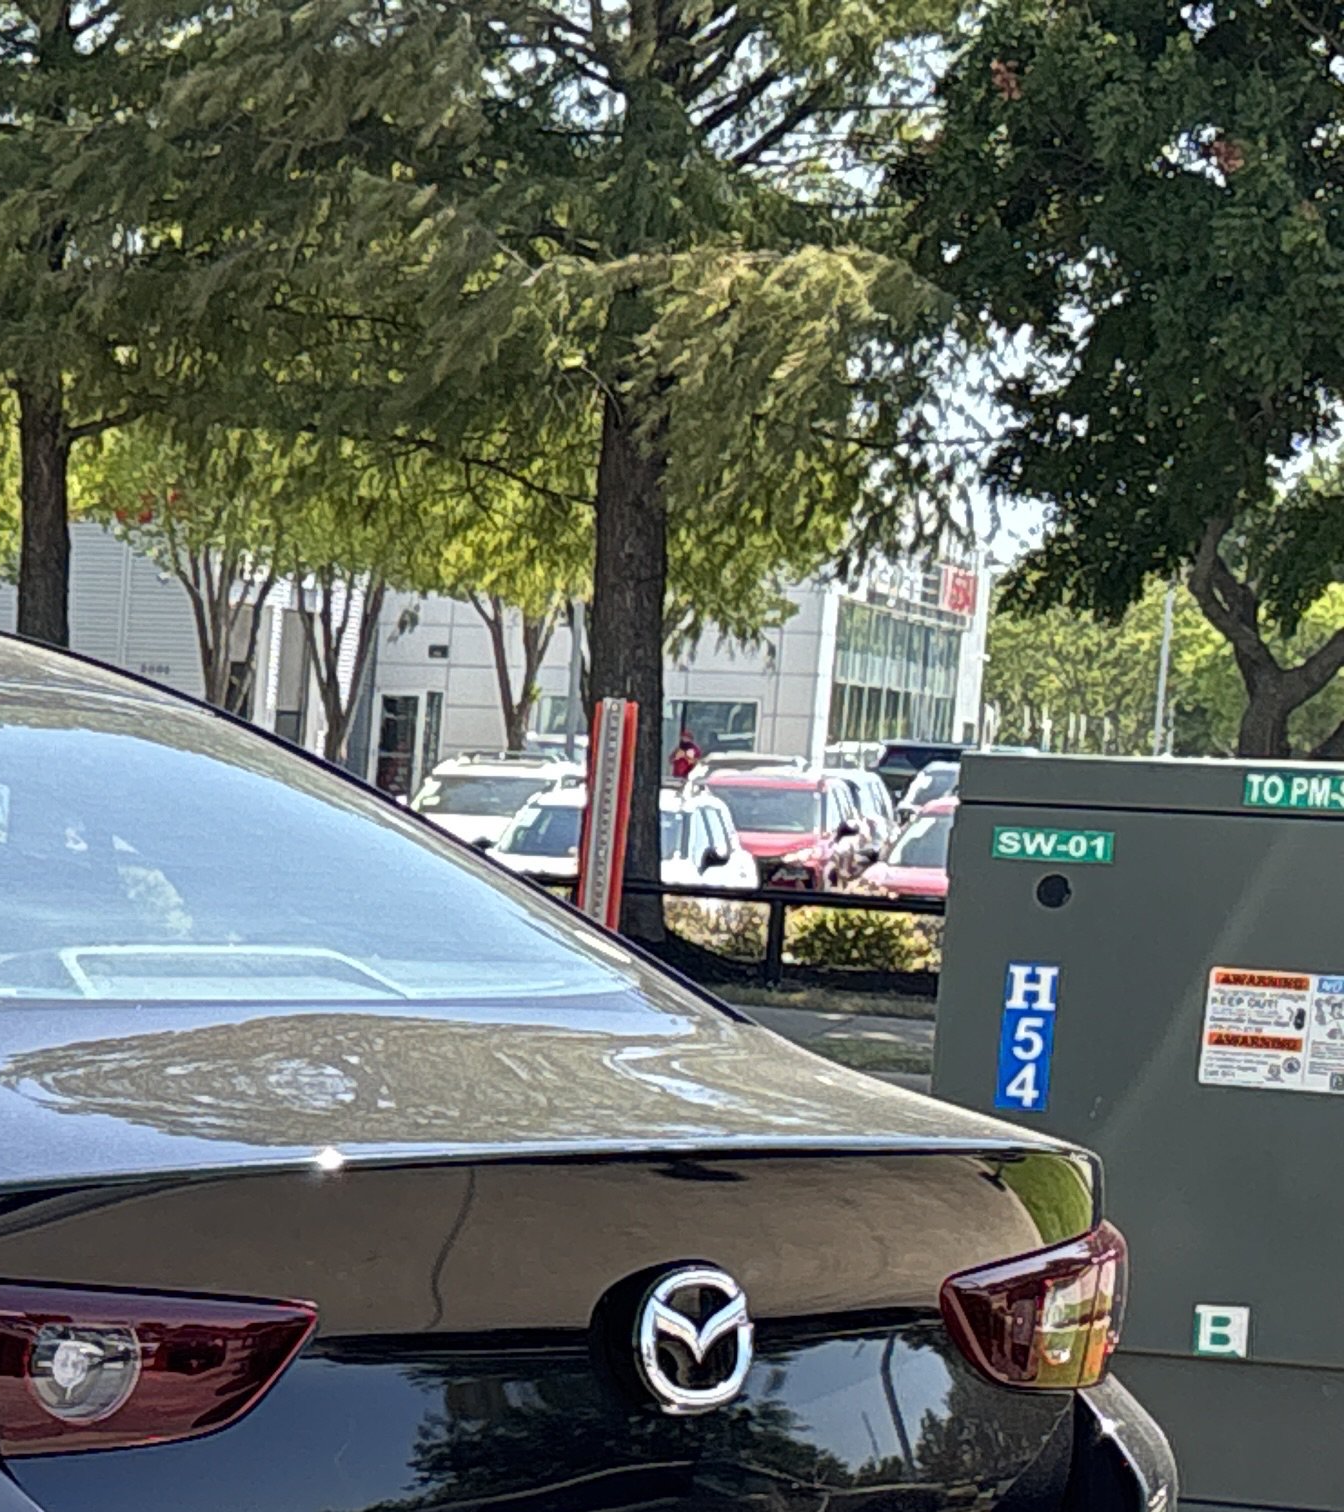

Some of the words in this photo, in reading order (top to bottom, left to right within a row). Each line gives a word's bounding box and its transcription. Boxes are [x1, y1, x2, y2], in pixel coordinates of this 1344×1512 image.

[1247, 773, 1284, 804] TO
[1290, 776, 1344, 808] PM-
[998, 831, 1105, 859] SW-01
[1198, 1311, 1236, 1352] B
